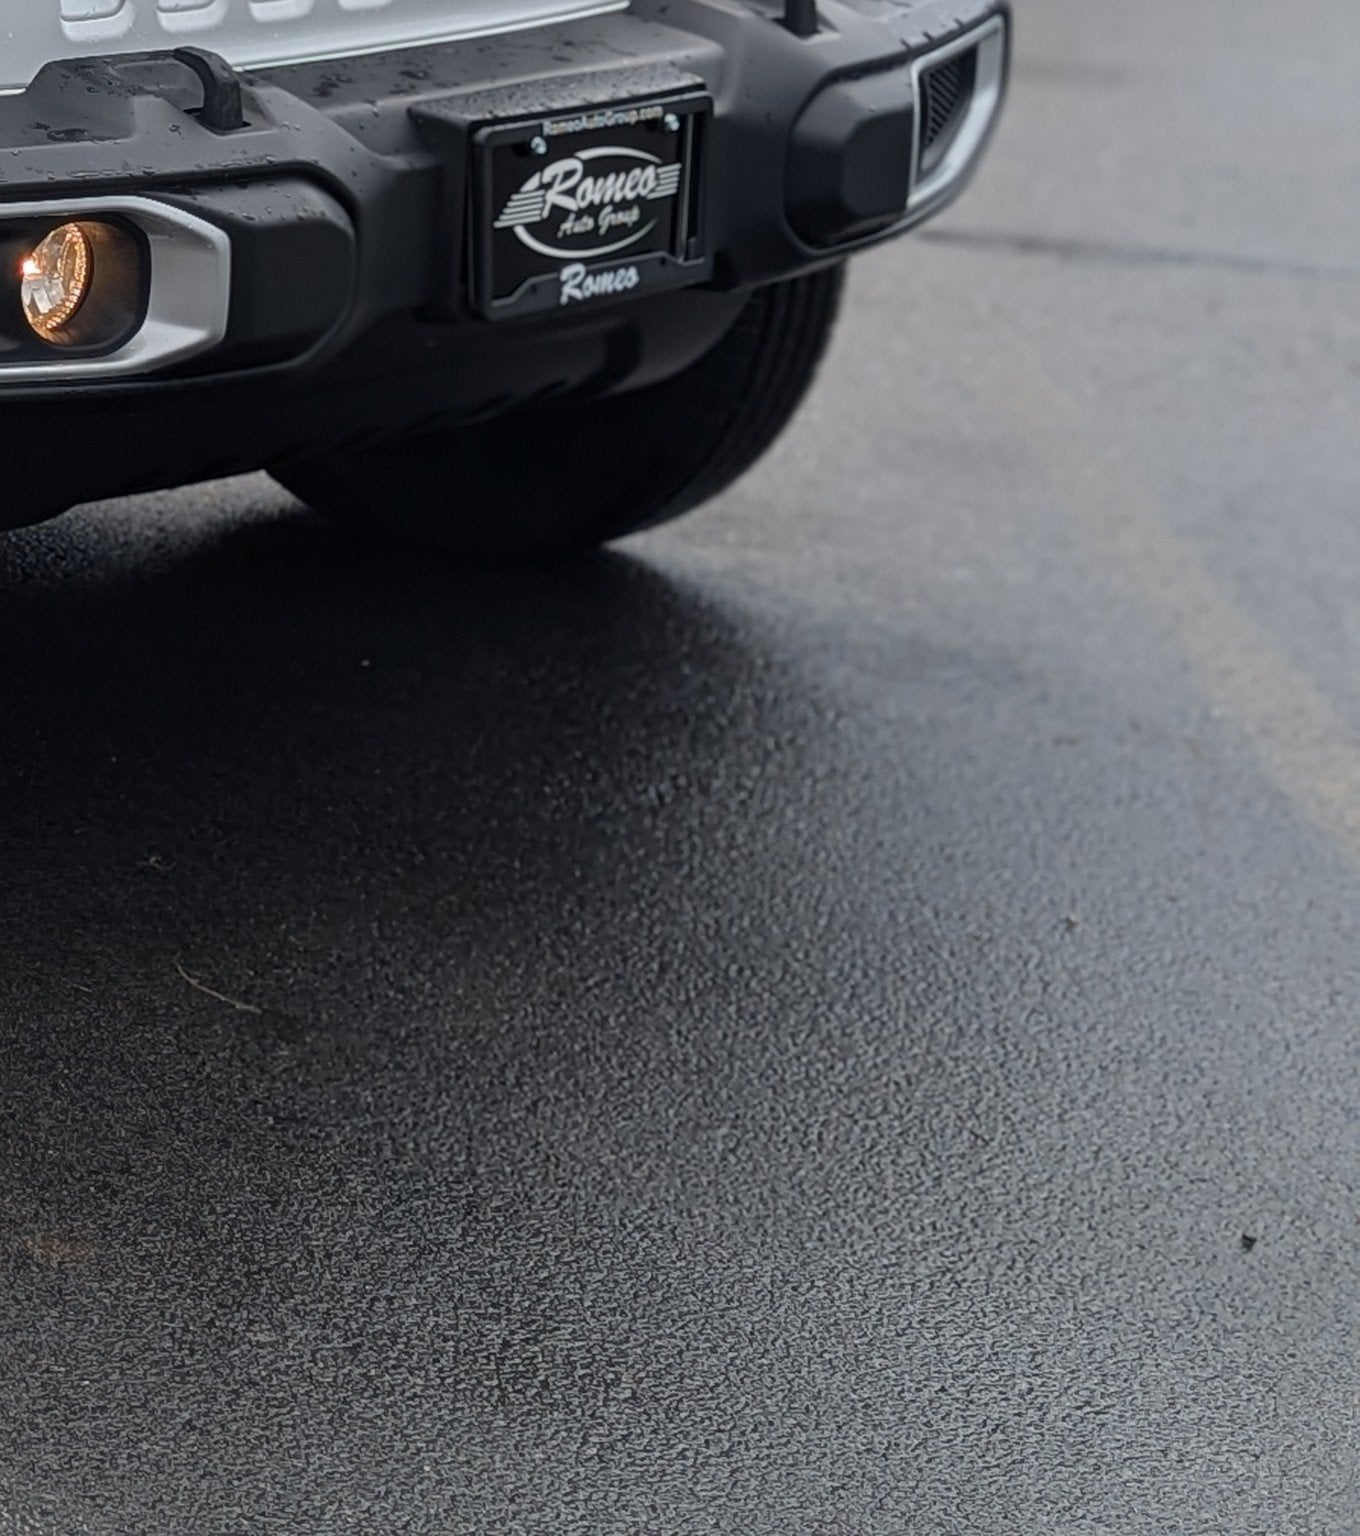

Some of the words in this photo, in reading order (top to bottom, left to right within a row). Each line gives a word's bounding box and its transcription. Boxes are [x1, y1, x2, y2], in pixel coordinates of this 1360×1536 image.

[541, 158, 658, 219] Romeo
[557, 212, 595, 238] Auto
[598, 204, 640, 236] Group
[560, 262, 639, 305] Romeo
